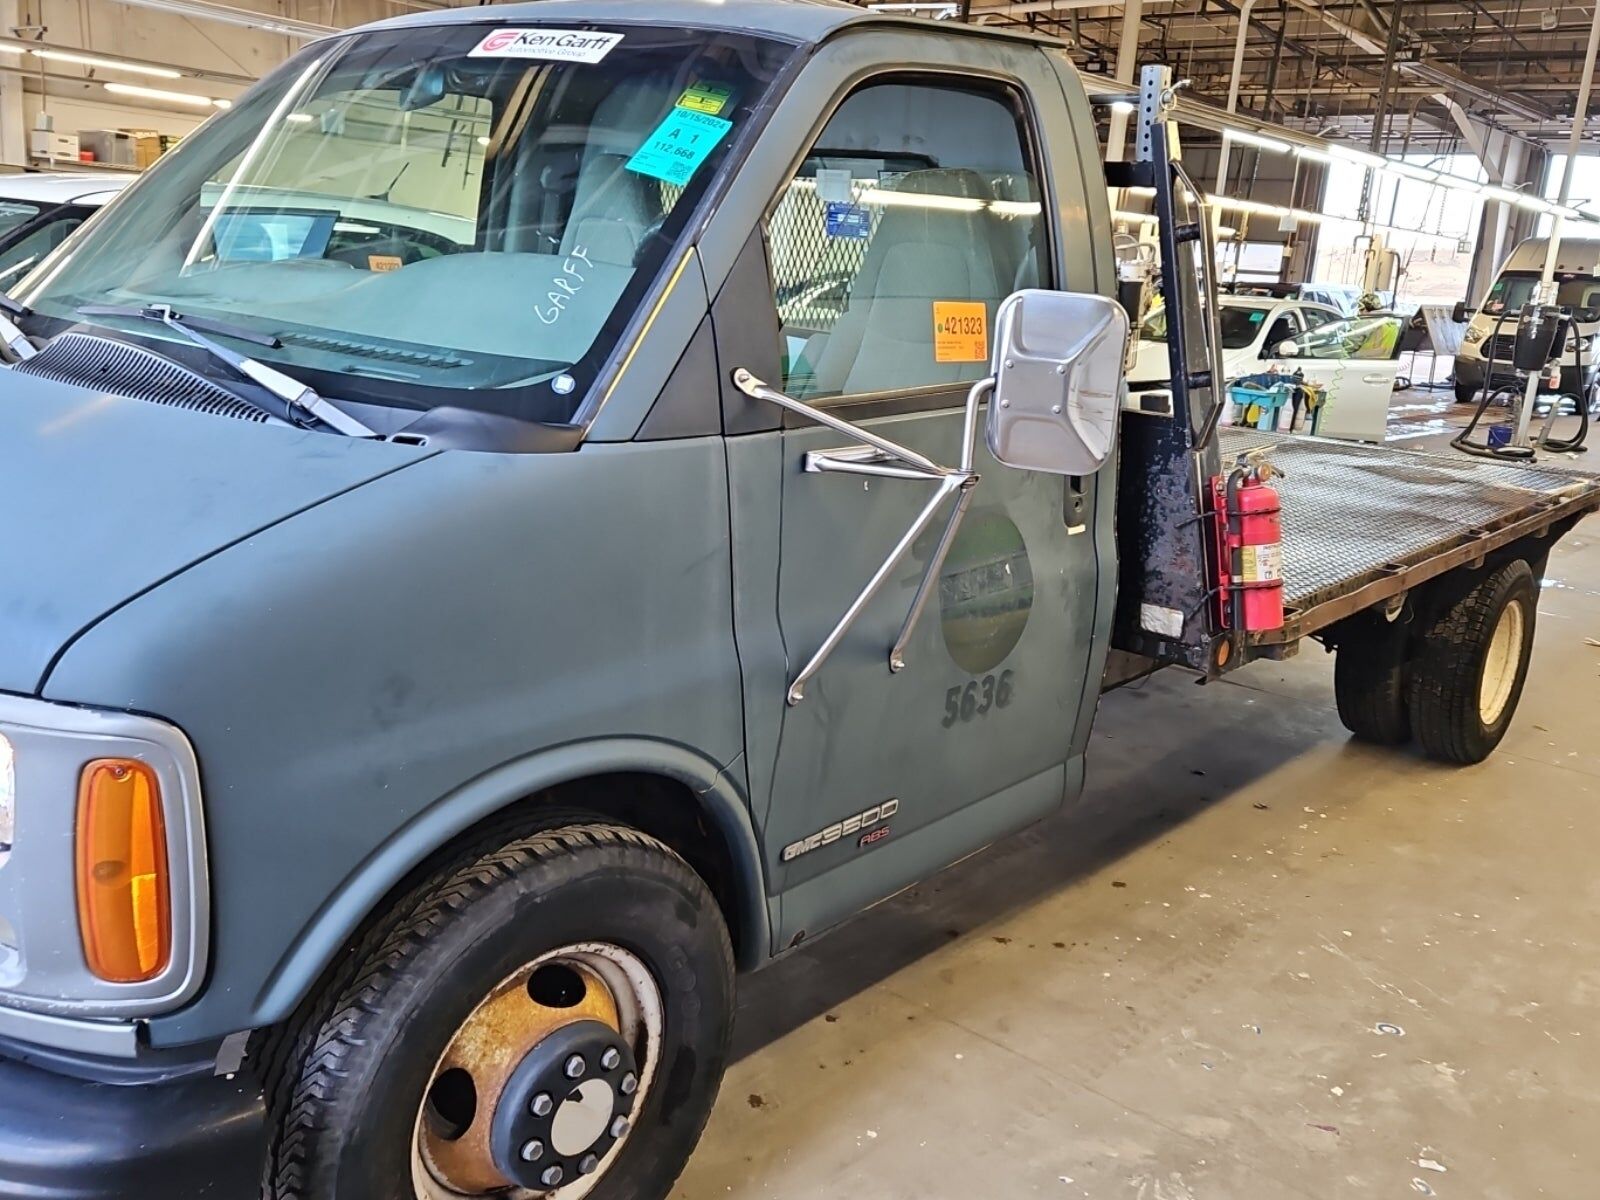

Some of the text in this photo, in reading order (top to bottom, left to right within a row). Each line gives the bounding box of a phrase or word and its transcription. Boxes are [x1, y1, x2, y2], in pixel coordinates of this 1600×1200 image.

[514, 32, 613, 50] Ken Garff
[676, 110, 727, 129] 10/15/2024
[668, 128, 700, 144] A 1
[534, 244, 593, 324] GARFF
[944, 316, 983, 335] 421323
[941, 668, 1015, 729] 5636
[860, 825, 890, 848] ABS
